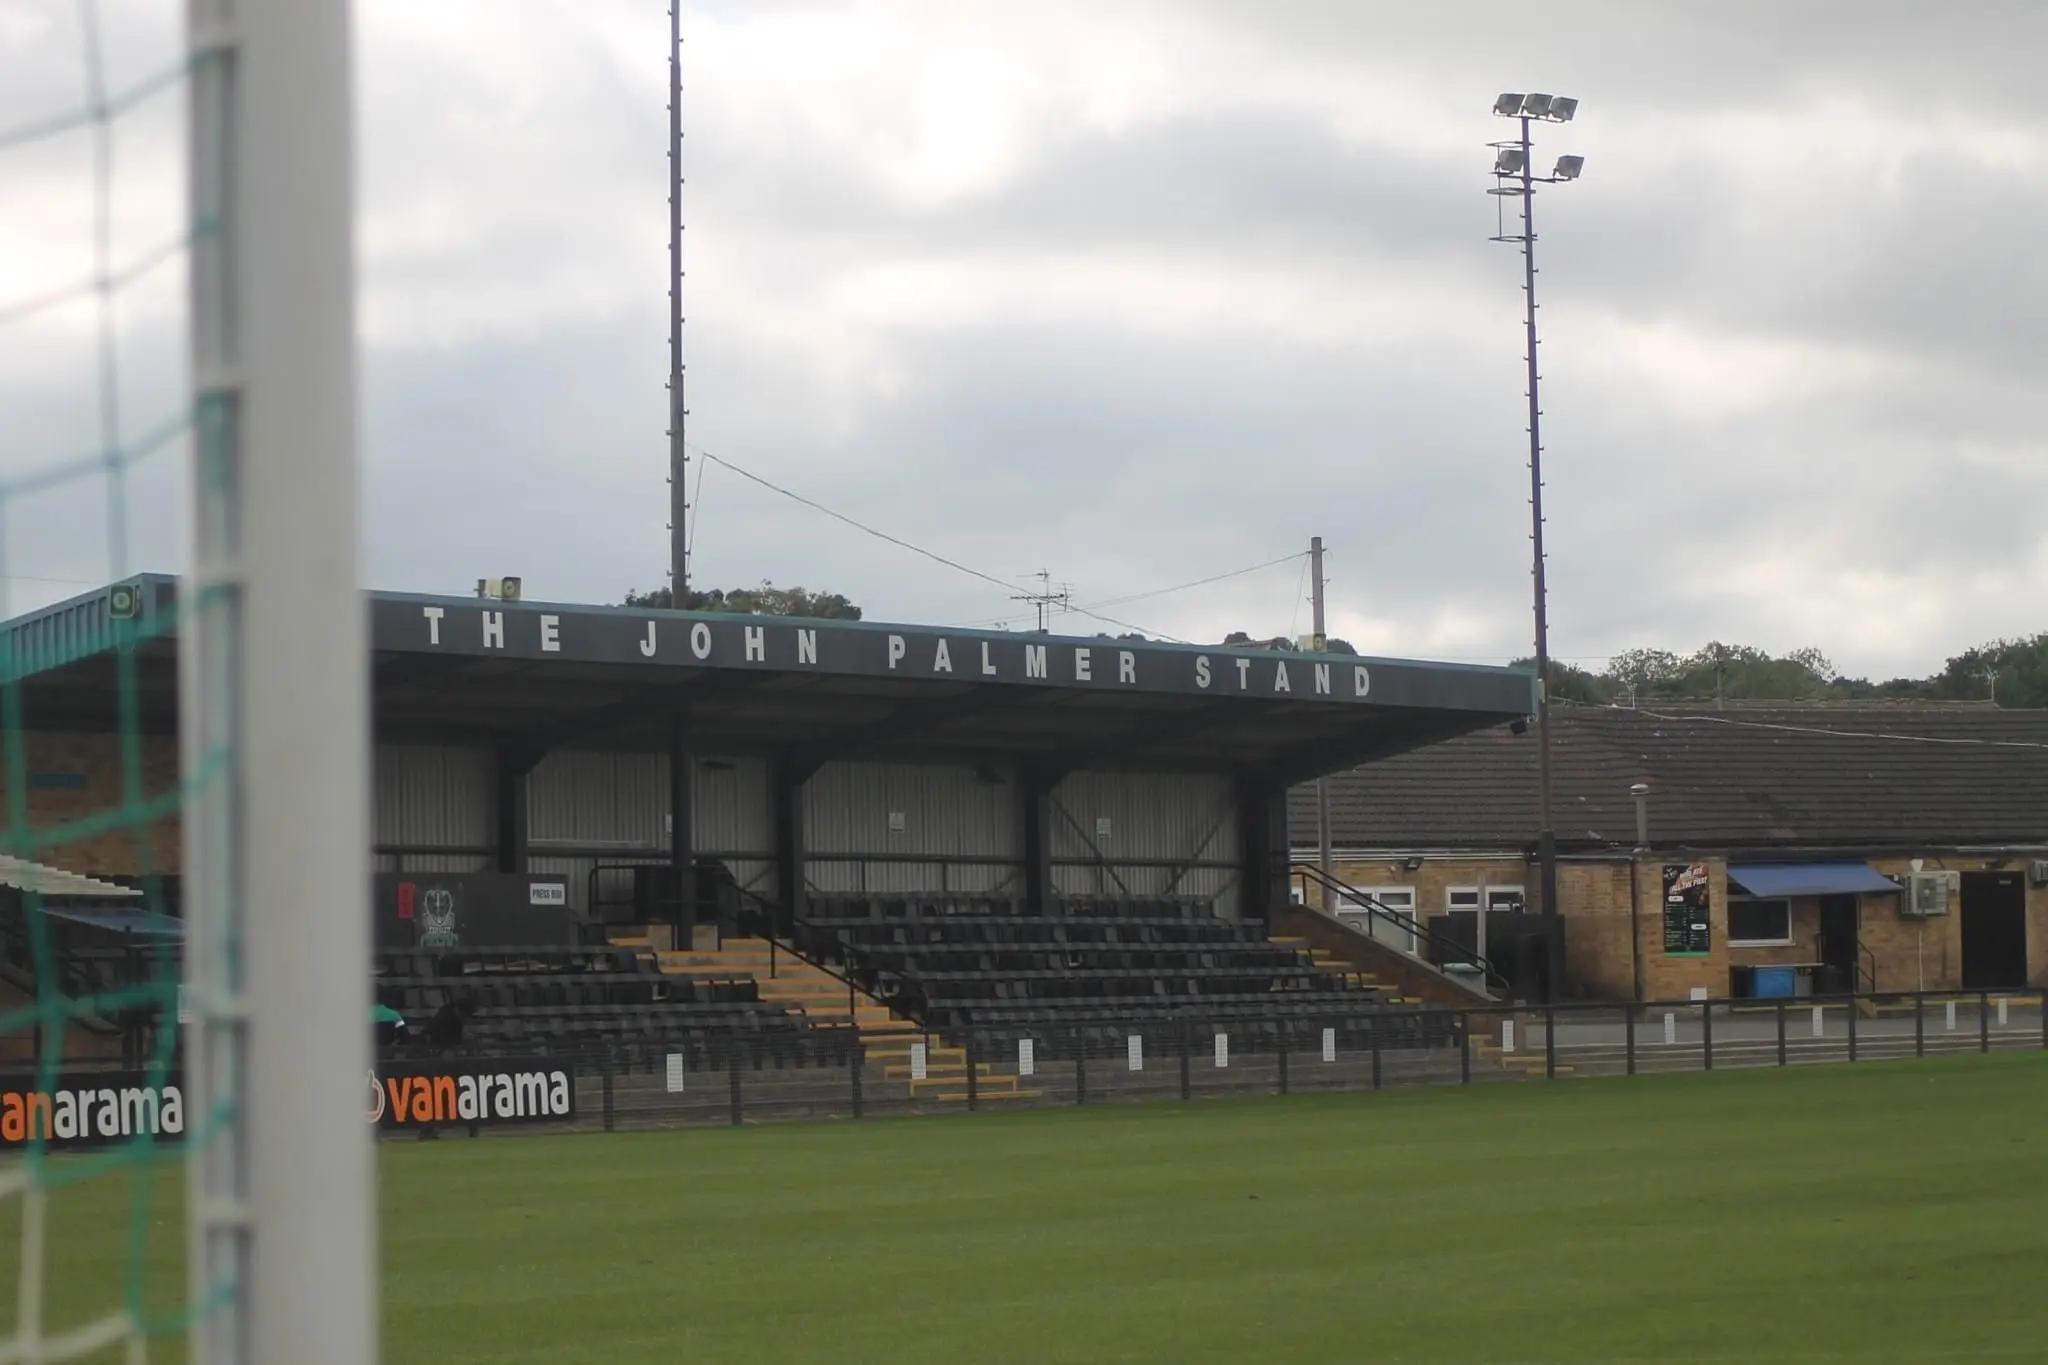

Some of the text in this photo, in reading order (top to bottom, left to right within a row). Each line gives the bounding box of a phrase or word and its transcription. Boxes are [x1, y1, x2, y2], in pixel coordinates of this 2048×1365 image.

[424, 606, 1370, 696] THE JOHN PALMER STAND
[532, 888, 550, 899] PRESS
[0, 1085, 183, 1141] anarama
[387, 1070, 570, 1123] vanarama
